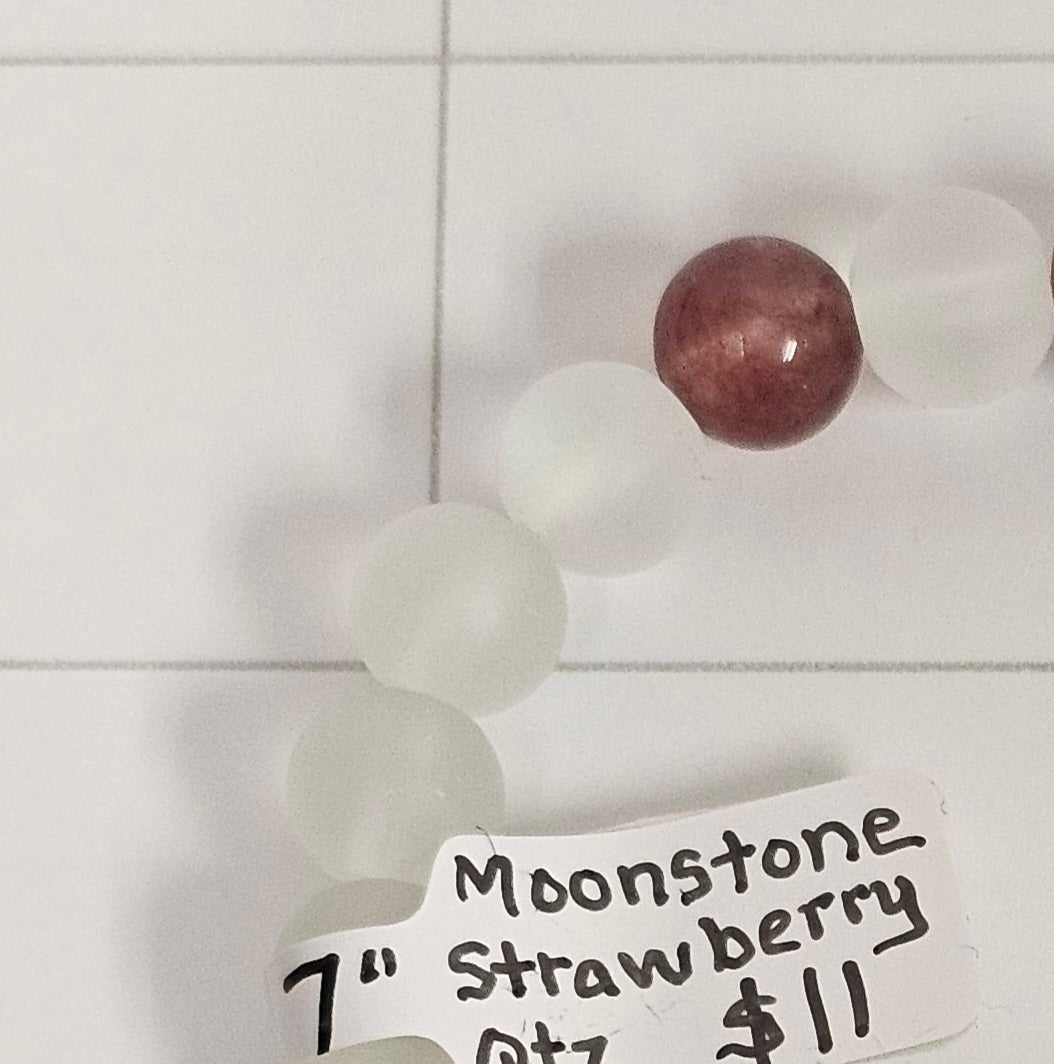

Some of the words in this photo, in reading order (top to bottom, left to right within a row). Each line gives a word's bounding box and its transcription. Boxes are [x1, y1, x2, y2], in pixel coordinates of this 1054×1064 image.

[453, 806, 928, 919] Moonstone
[447, 874, 930, 1003] Strawberry
[282, 946, 398, 1056] 7"
